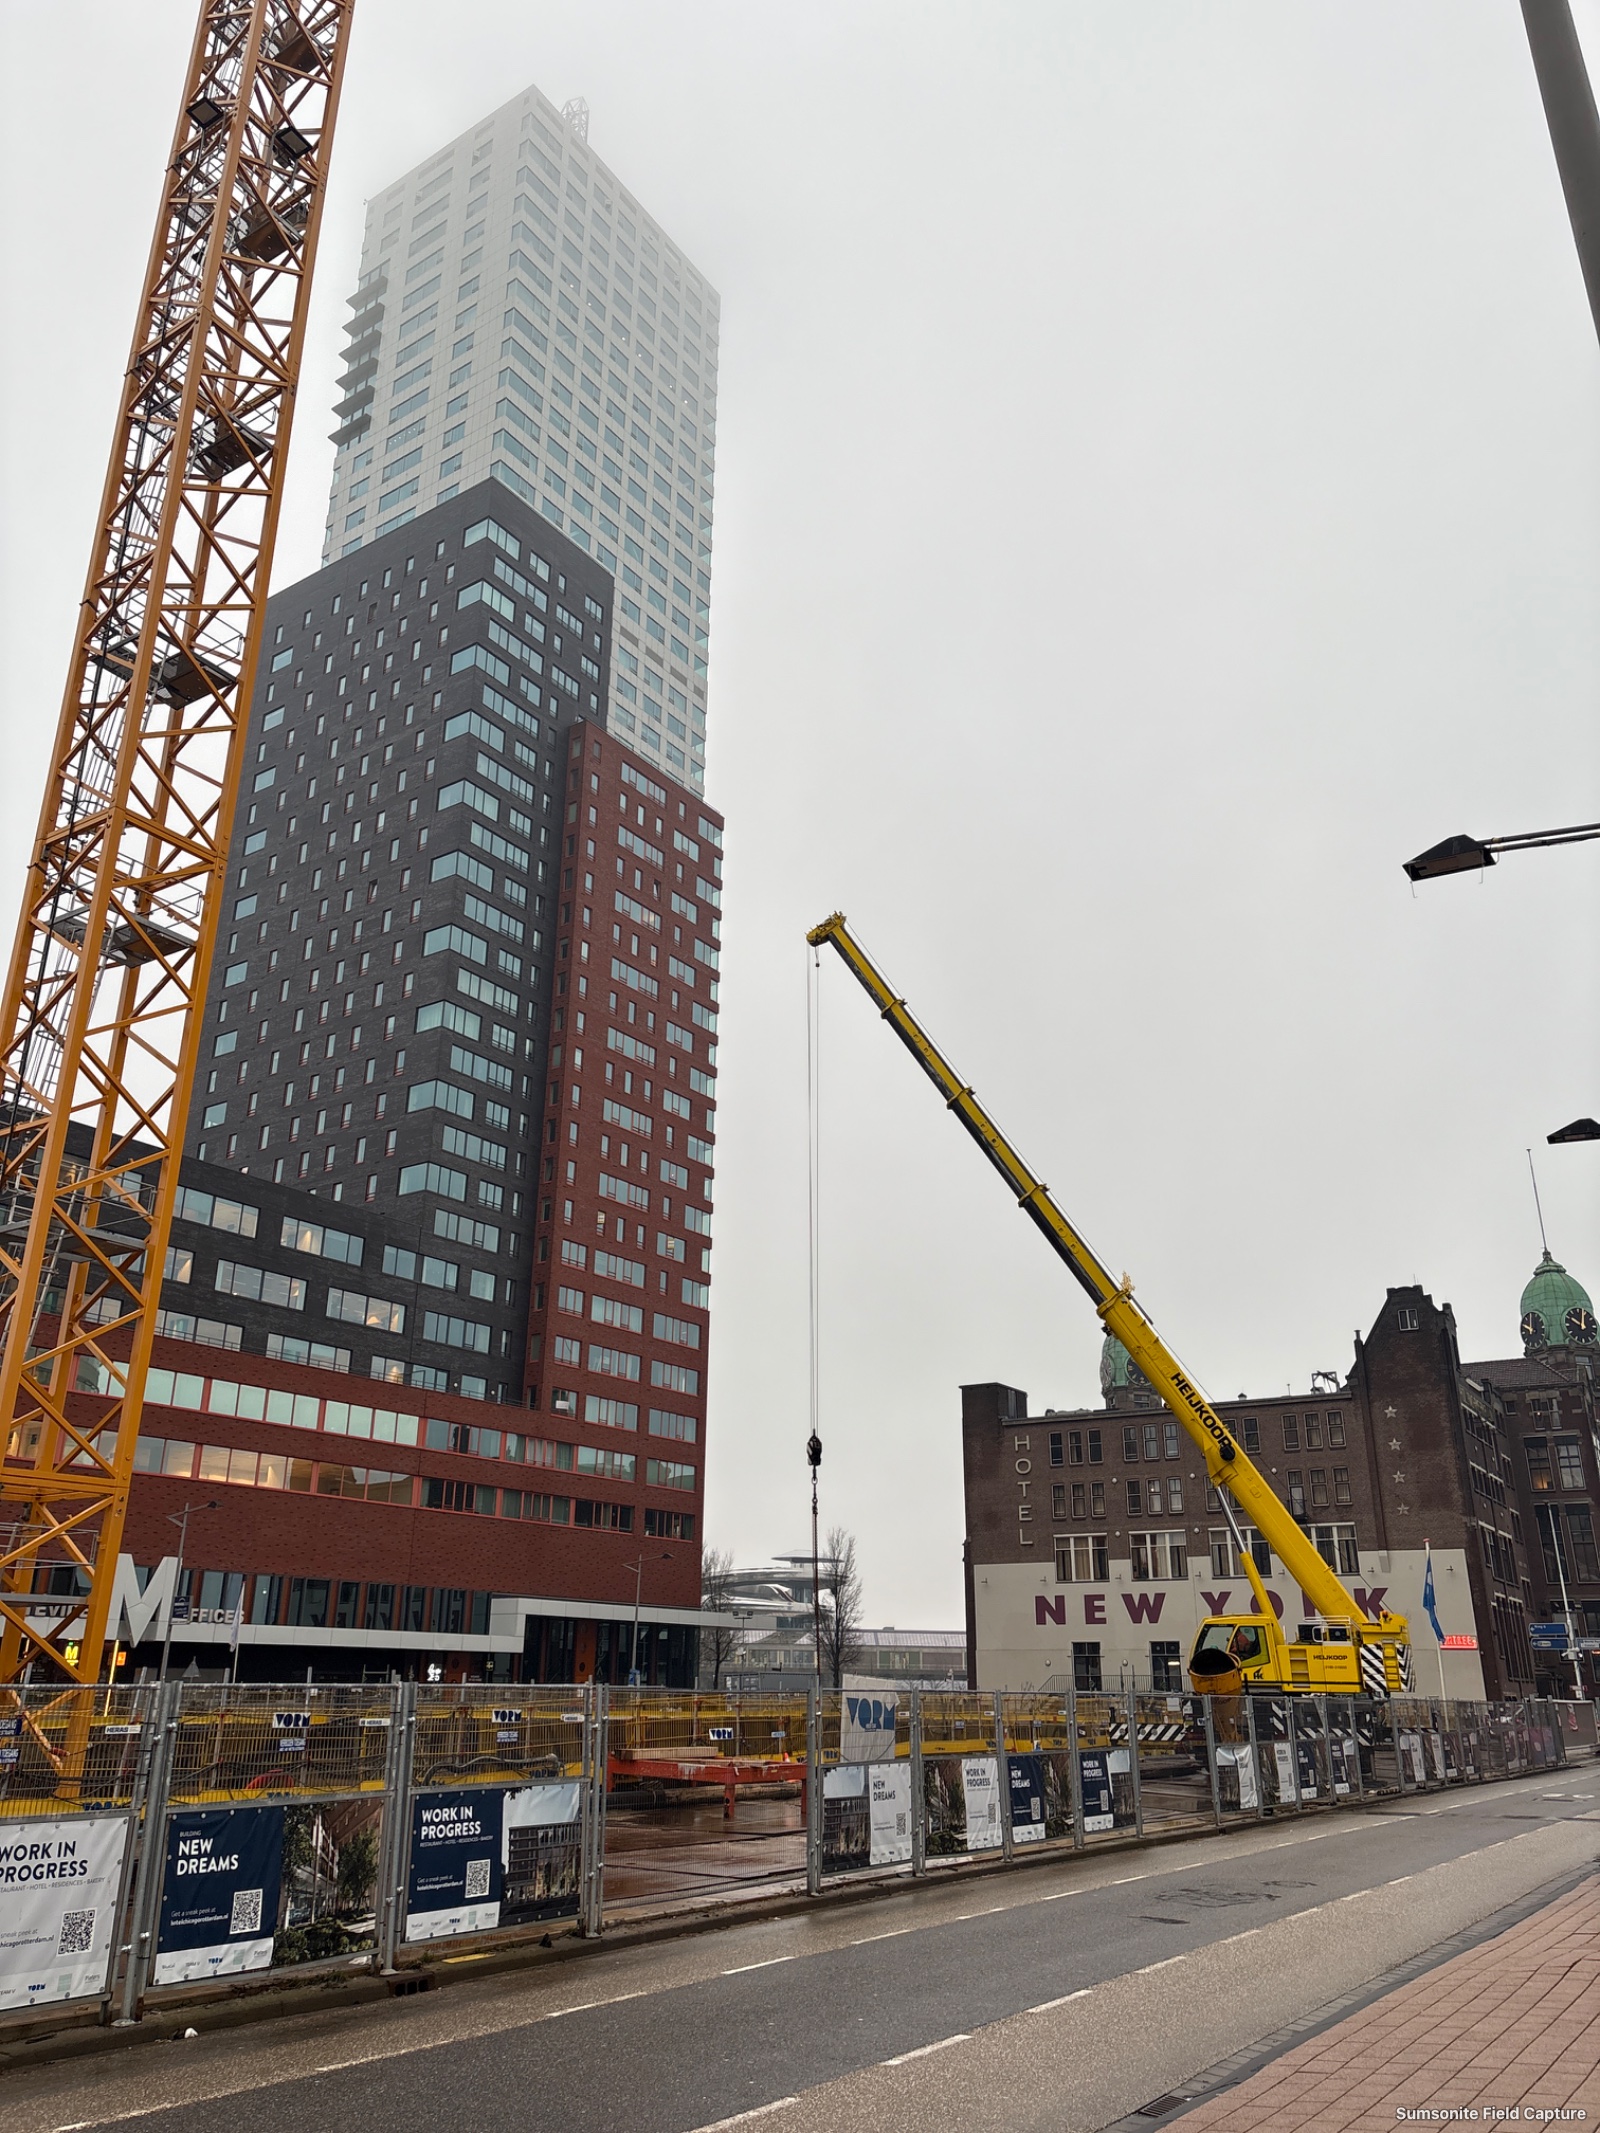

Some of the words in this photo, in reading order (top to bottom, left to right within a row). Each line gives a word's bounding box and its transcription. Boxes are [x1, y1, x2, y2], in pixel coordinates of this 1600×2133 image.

[1170, 1372, 1233, 1448] HEIJKOOP
[1014, 1435, 1034, 1545] HOTEL
[1035, 1592, 1166, 1625] NEW
[275, 1713, 310, 1727] VORM
[494, 1710, 521, 1722] VORM
[846, 1697, 895, 1730] VORM
[709, 1729, 732, 1739] VORM
[965, 1768, 980, 1777] WORK
[1011, 1769, 1022, 1779] NEW
[873, 1780, 886, 1790] NEW
[966, 1777, 991, 1787] PROGRESS
[1011, 1779, 1031, 1789] DREAMS
[873, 1790, 896, 1802] DREAMS
[421, 1807, 458, 1823] WORK
[460, 1806, 473, 1820] IN
[421, 1821, 482, 1840] PROGRESS
[57, 1840, 76, 1858] IN
[178, 1838, 213, 1856] NEW
[176, 1854, 239, 1876] DREAMS
[51, 1879, 83, 1888] RESIDENCES
[87, 1877, 106, 1885] BAKERY
[28, 1983, 46, 1991] VORM
